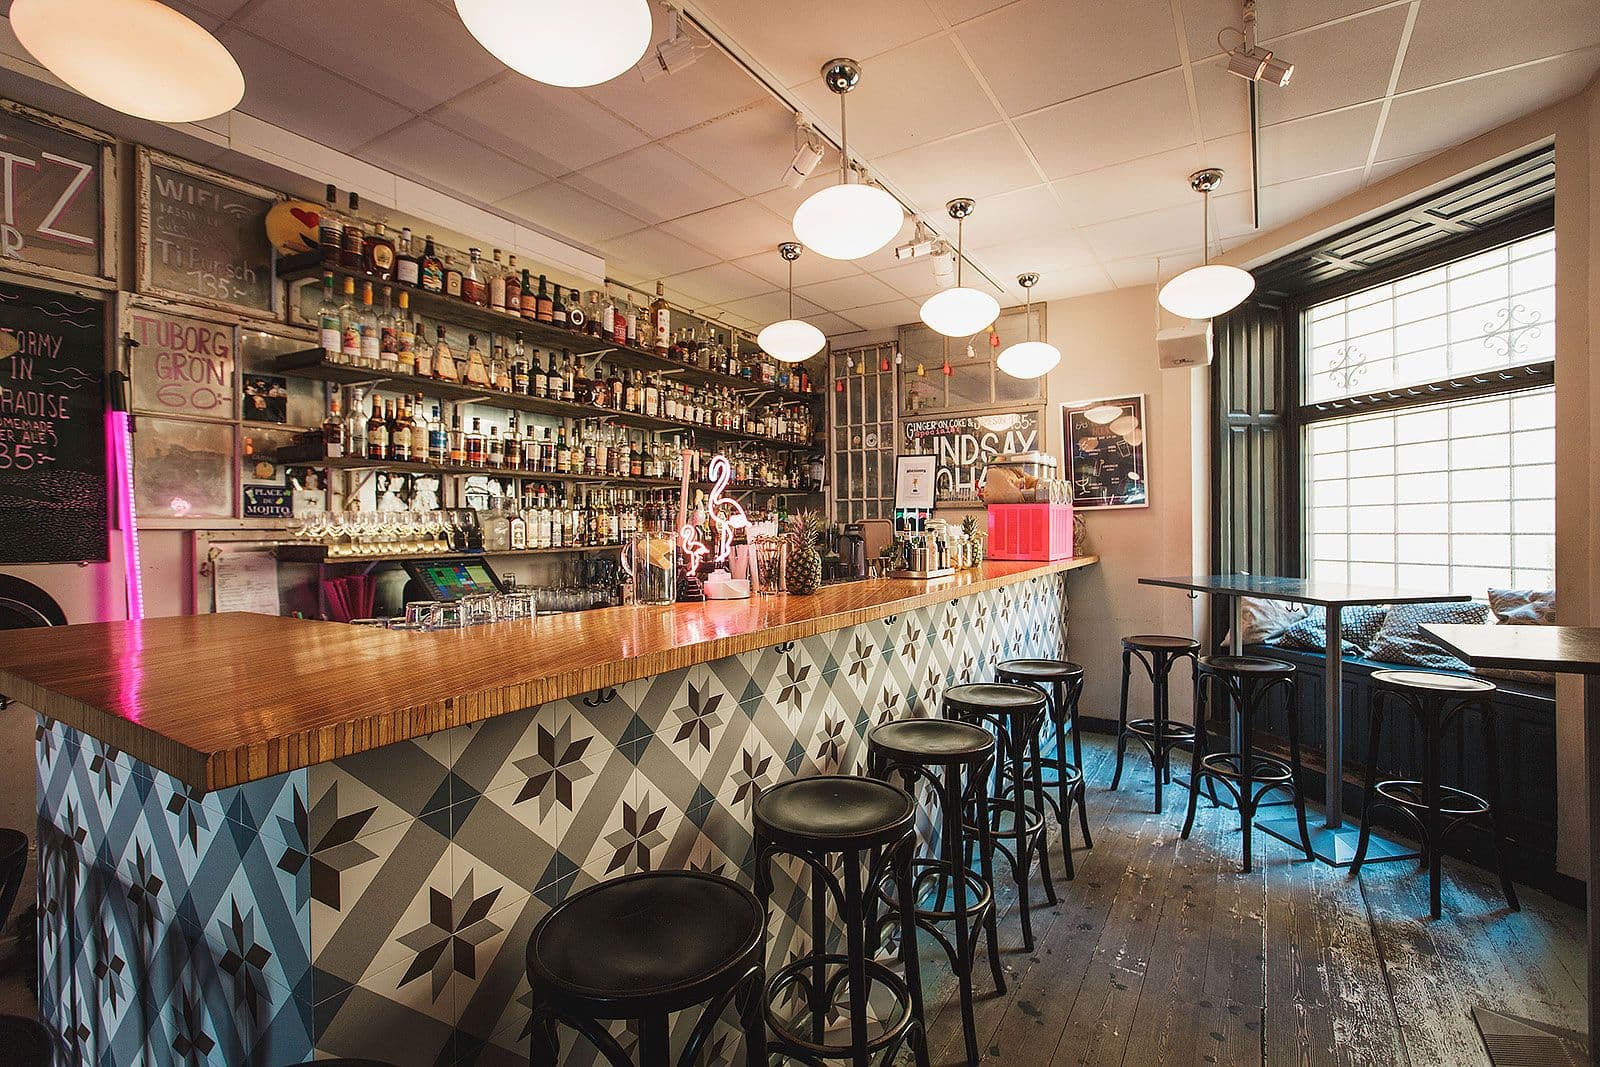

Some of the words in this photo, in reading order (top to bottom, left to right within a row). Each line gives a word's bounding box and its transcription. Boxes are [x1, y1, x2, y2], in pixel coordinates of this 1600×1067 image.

[155, 174, 220, 211] WIFI
[133, 315, 229, 358] TUBORG
[10, 356, 33, 380] IN
[155, 352, 224, 386] GRÖN
[157, 383, 231, 409] 60:-
[254, 488, 283, 497] PLACE
[247, 505, 291, 516] MOJITO
